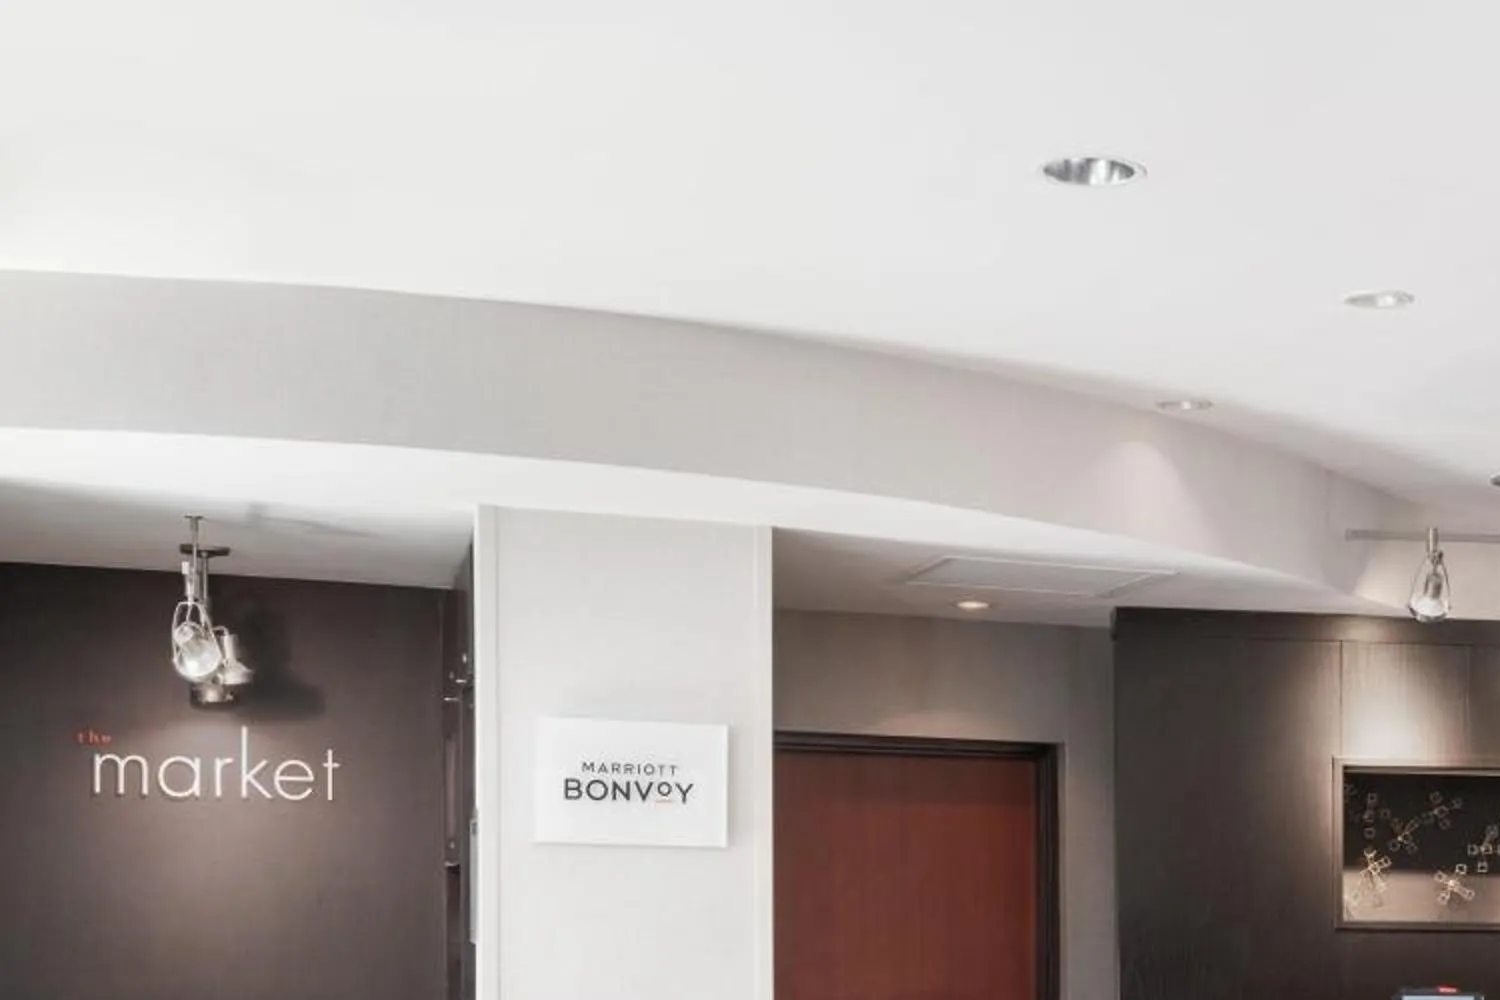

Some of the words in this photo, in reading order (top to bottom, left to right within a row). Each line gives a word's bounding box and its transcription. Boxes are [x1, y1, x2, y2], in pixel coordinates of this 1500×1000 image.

[77, 729, 112, 745] the
[94, 725, 341, 801] market
[581, 761, 678, 777] MARRIOTT
[563, 778, 694, 804] BONVOY
